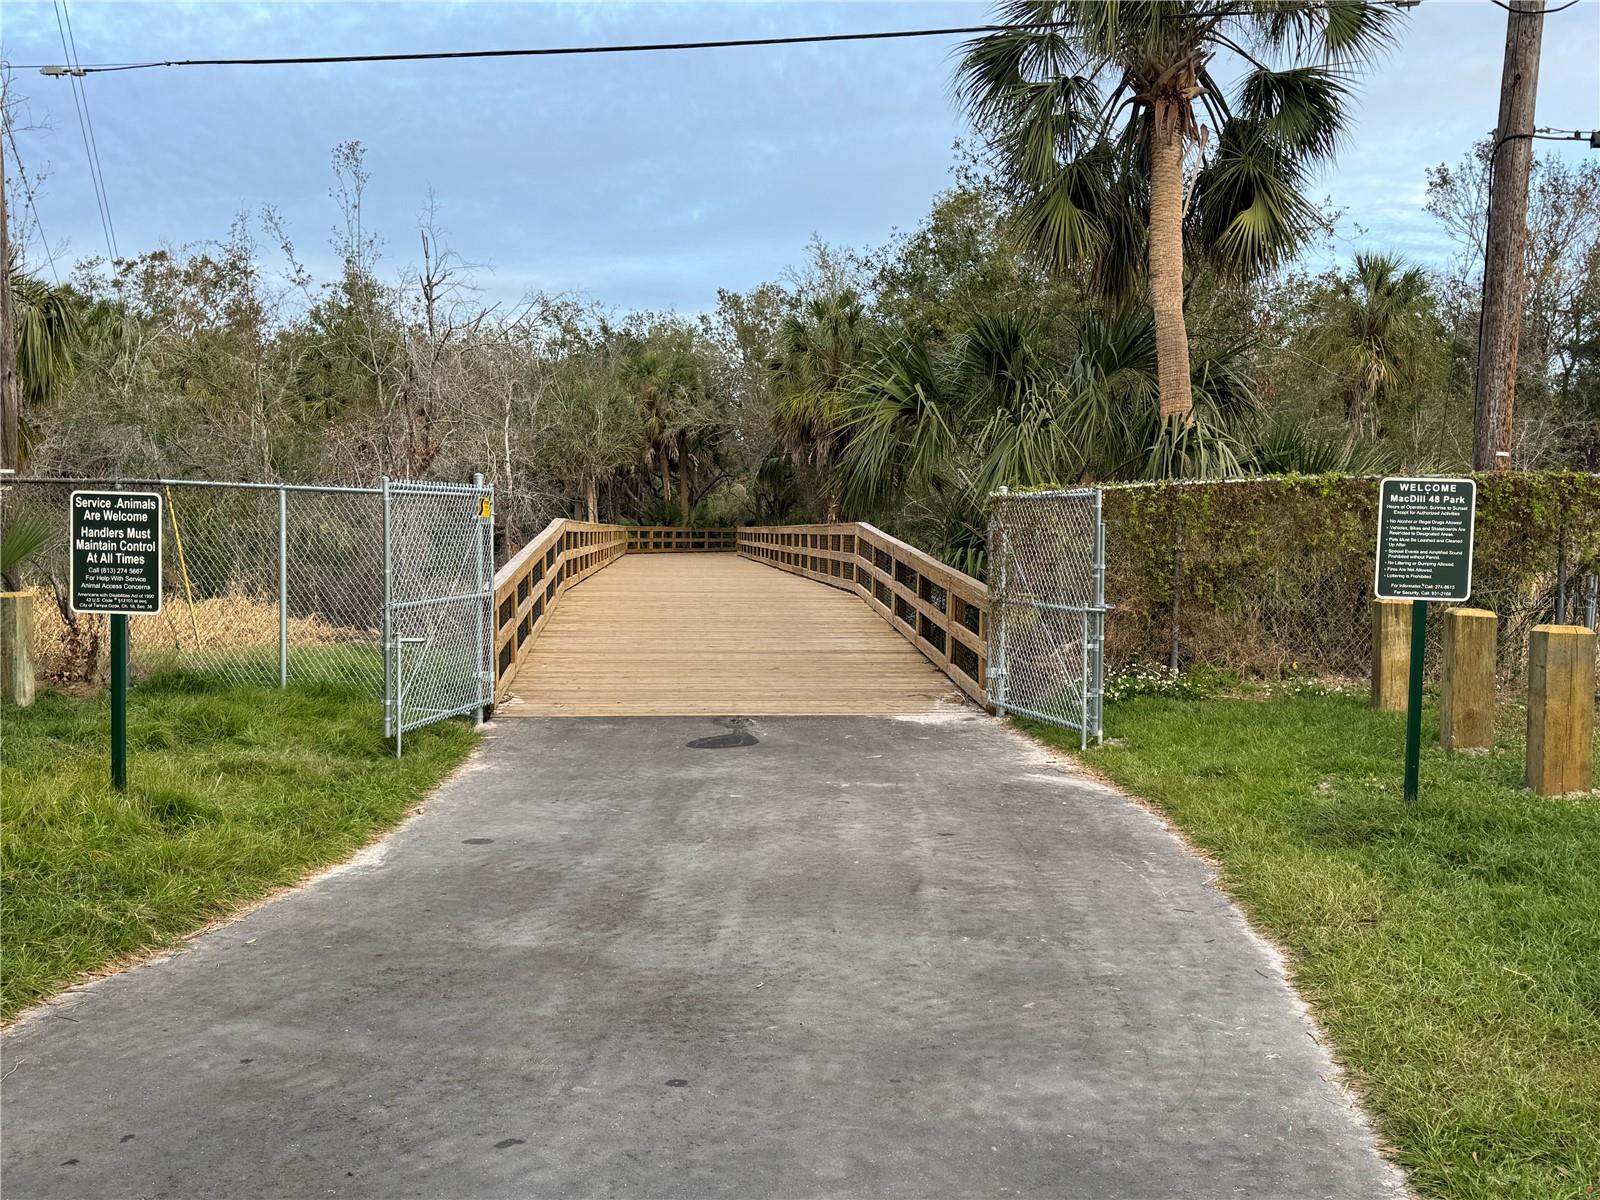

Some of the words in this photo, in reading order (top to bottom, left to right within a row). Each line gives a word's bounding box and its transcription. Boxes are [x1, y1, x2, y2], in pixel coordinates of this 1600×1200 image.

[1400, 484, 1456, 492] WELCOME
[76, 497, 111, 508] Service
[117, 498, 156, 509] Animals
[84, 510, 100, 520] Are
[103, 510, 148, 522] Welcome
[81, 527, 124, 538] Handlers
[127, 528, 150, 539] Must
[76, 540, 116, 551] Maintain
[120, 541, 155, 551] Control
[86, 553, 97, 563] At
[100, 553, 112, 563] All
[116, 553, 145, 564] Times
